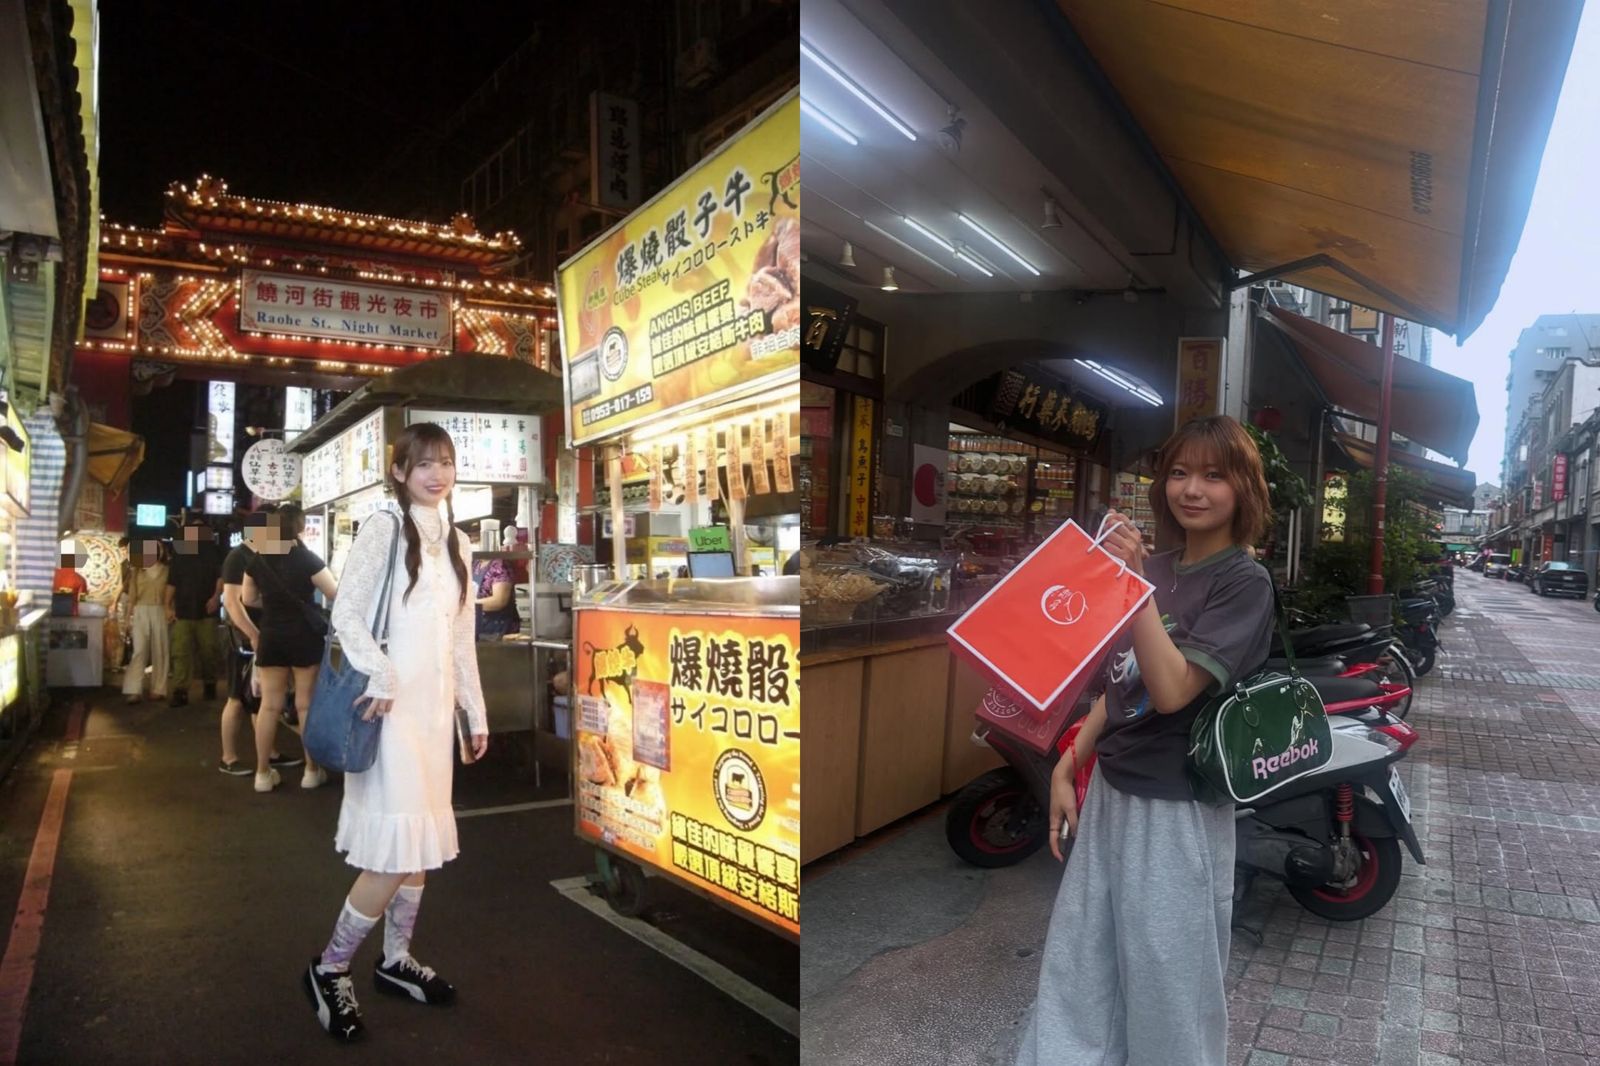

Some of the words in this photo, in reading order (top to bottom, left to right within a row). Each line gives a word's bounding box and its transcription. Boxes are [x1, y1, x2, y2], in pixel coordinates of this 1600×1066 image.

[616, 169, 751, 286] 爆燒骰子牛
[255, 281, 439, 321] 饒河街觀光夜市
[613, 285, 636, 306] Cube
[637, 265, 662, 294] Steak
[256, 311, 301, 327] Raohe
[311, 313, 332, 329] St.
[342, 319, 380, 335] Night
[389, 324, 439, 340] Market
[649, 300, 691, 337] ANGUS
[692, 280, 730, 314] BEEF
[695, 536, 723, 547] Uber
[670, 635, 800, 707] 爆燒骰
[1252, 738, 1319, 780] Reebok
